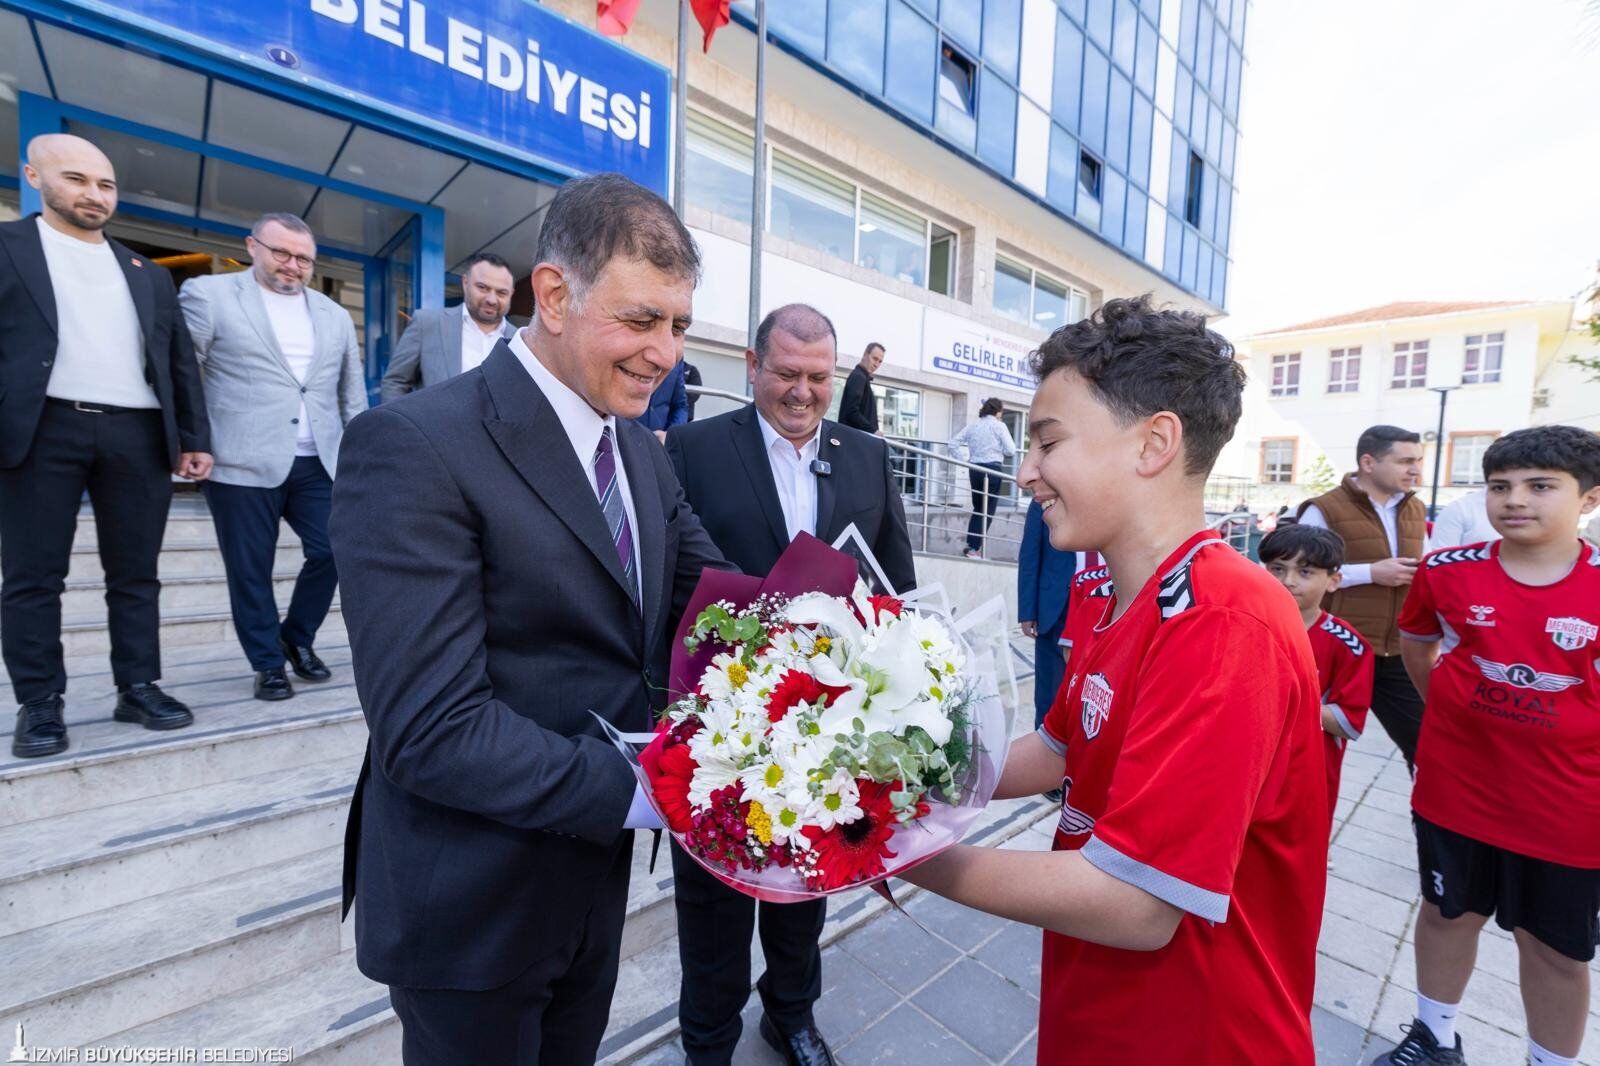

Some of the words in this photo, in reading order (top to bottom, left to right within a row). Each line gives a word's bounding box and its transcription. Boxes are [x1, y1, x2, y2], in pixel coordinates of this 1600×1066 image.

[953, 341, 1014, 371] GELİRLER
[1548, 619, 1597, 639] MENDERES
[1512, 668, 1530, 685] R
[1474, 681, 1561, 716] ROYAL
[1431, 870, 1445, 896] 3
